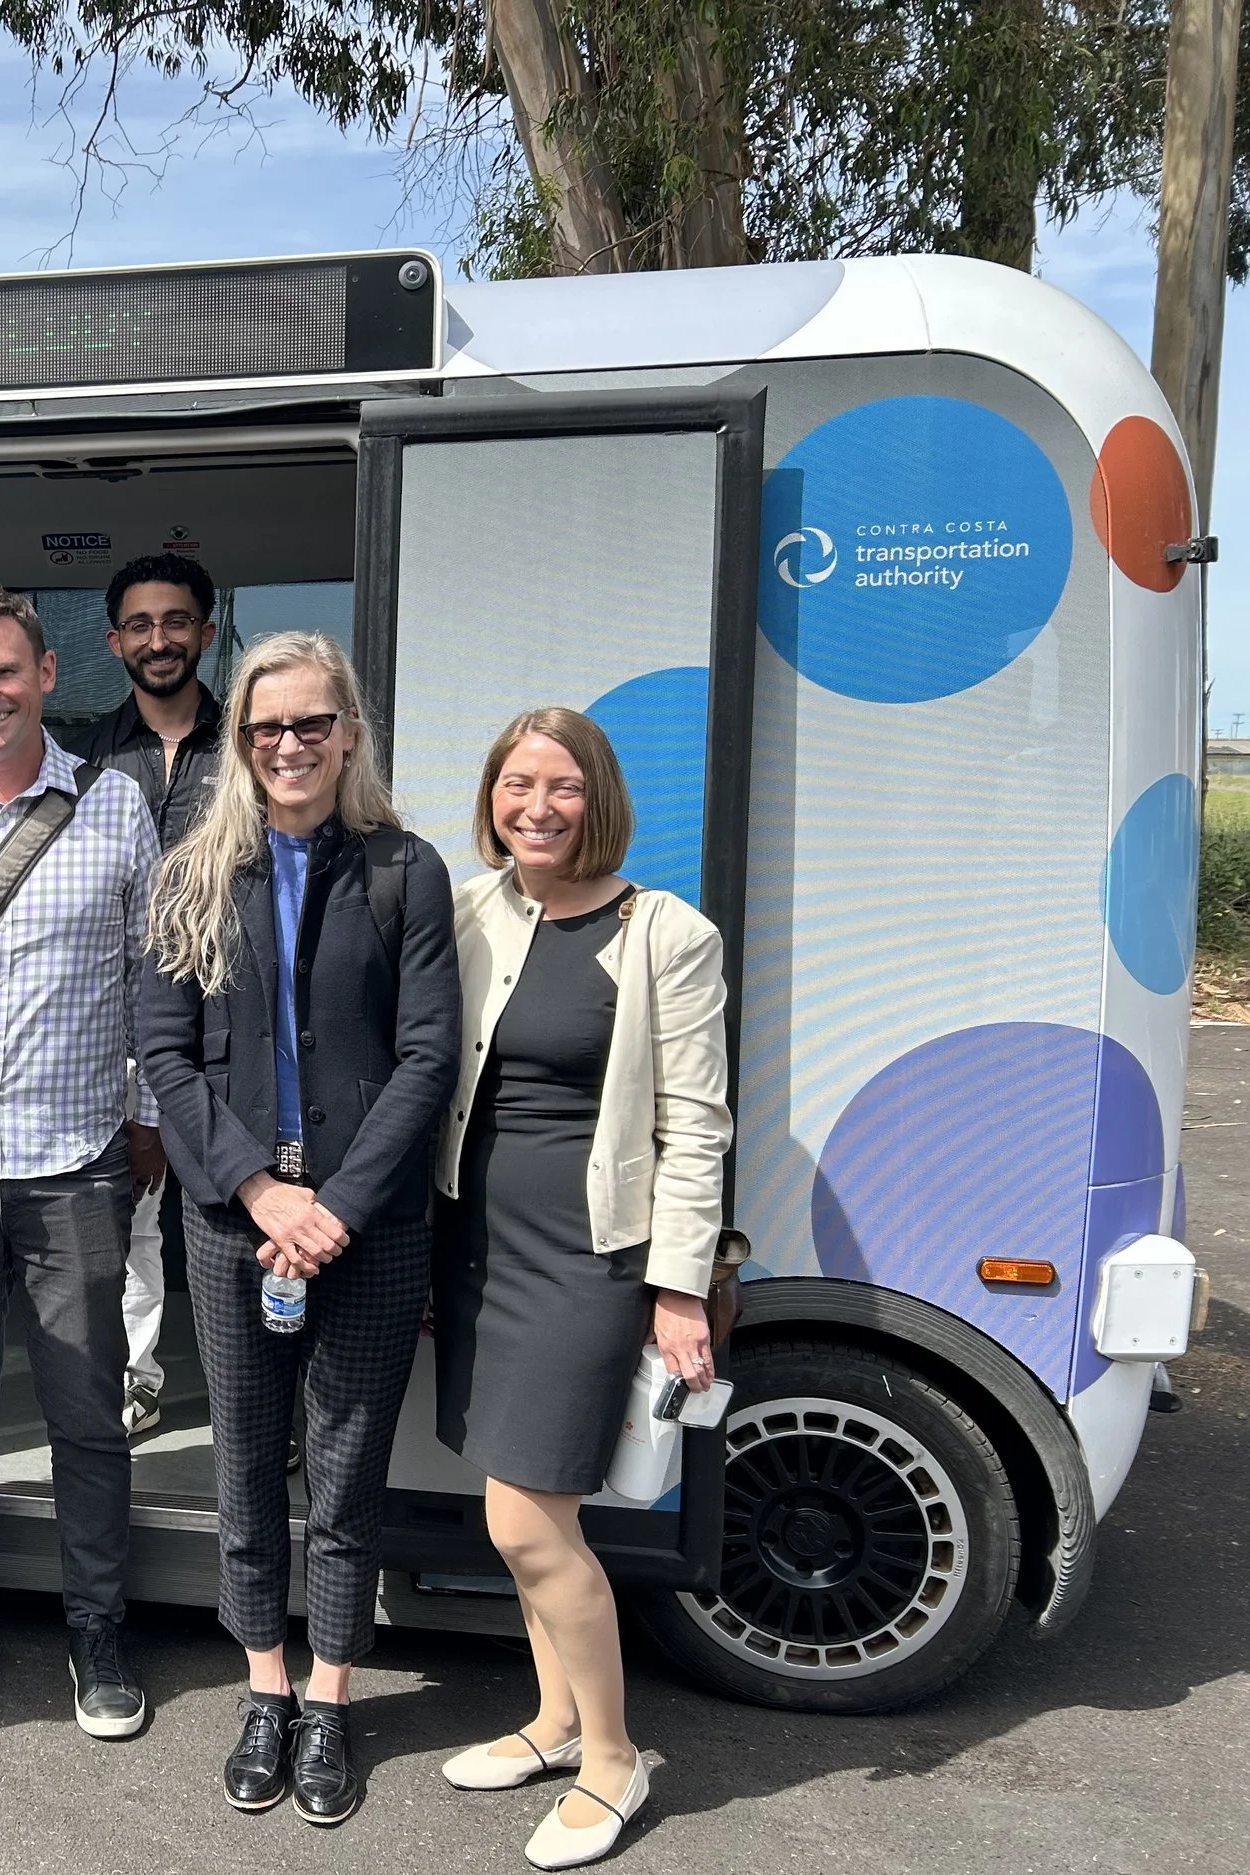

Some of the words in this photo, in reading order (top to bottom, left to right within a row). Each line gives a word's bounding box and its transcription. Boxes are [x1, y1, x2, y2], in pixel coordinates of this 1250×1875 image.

[856, 523, 934, 536] CONTRA
[945, 520, 1008, 533] COSTA
[46, 535, 109, 547] NOTICE
[855, 538, 1030, 567] transportation
[855, 565, 964, 591] authority
